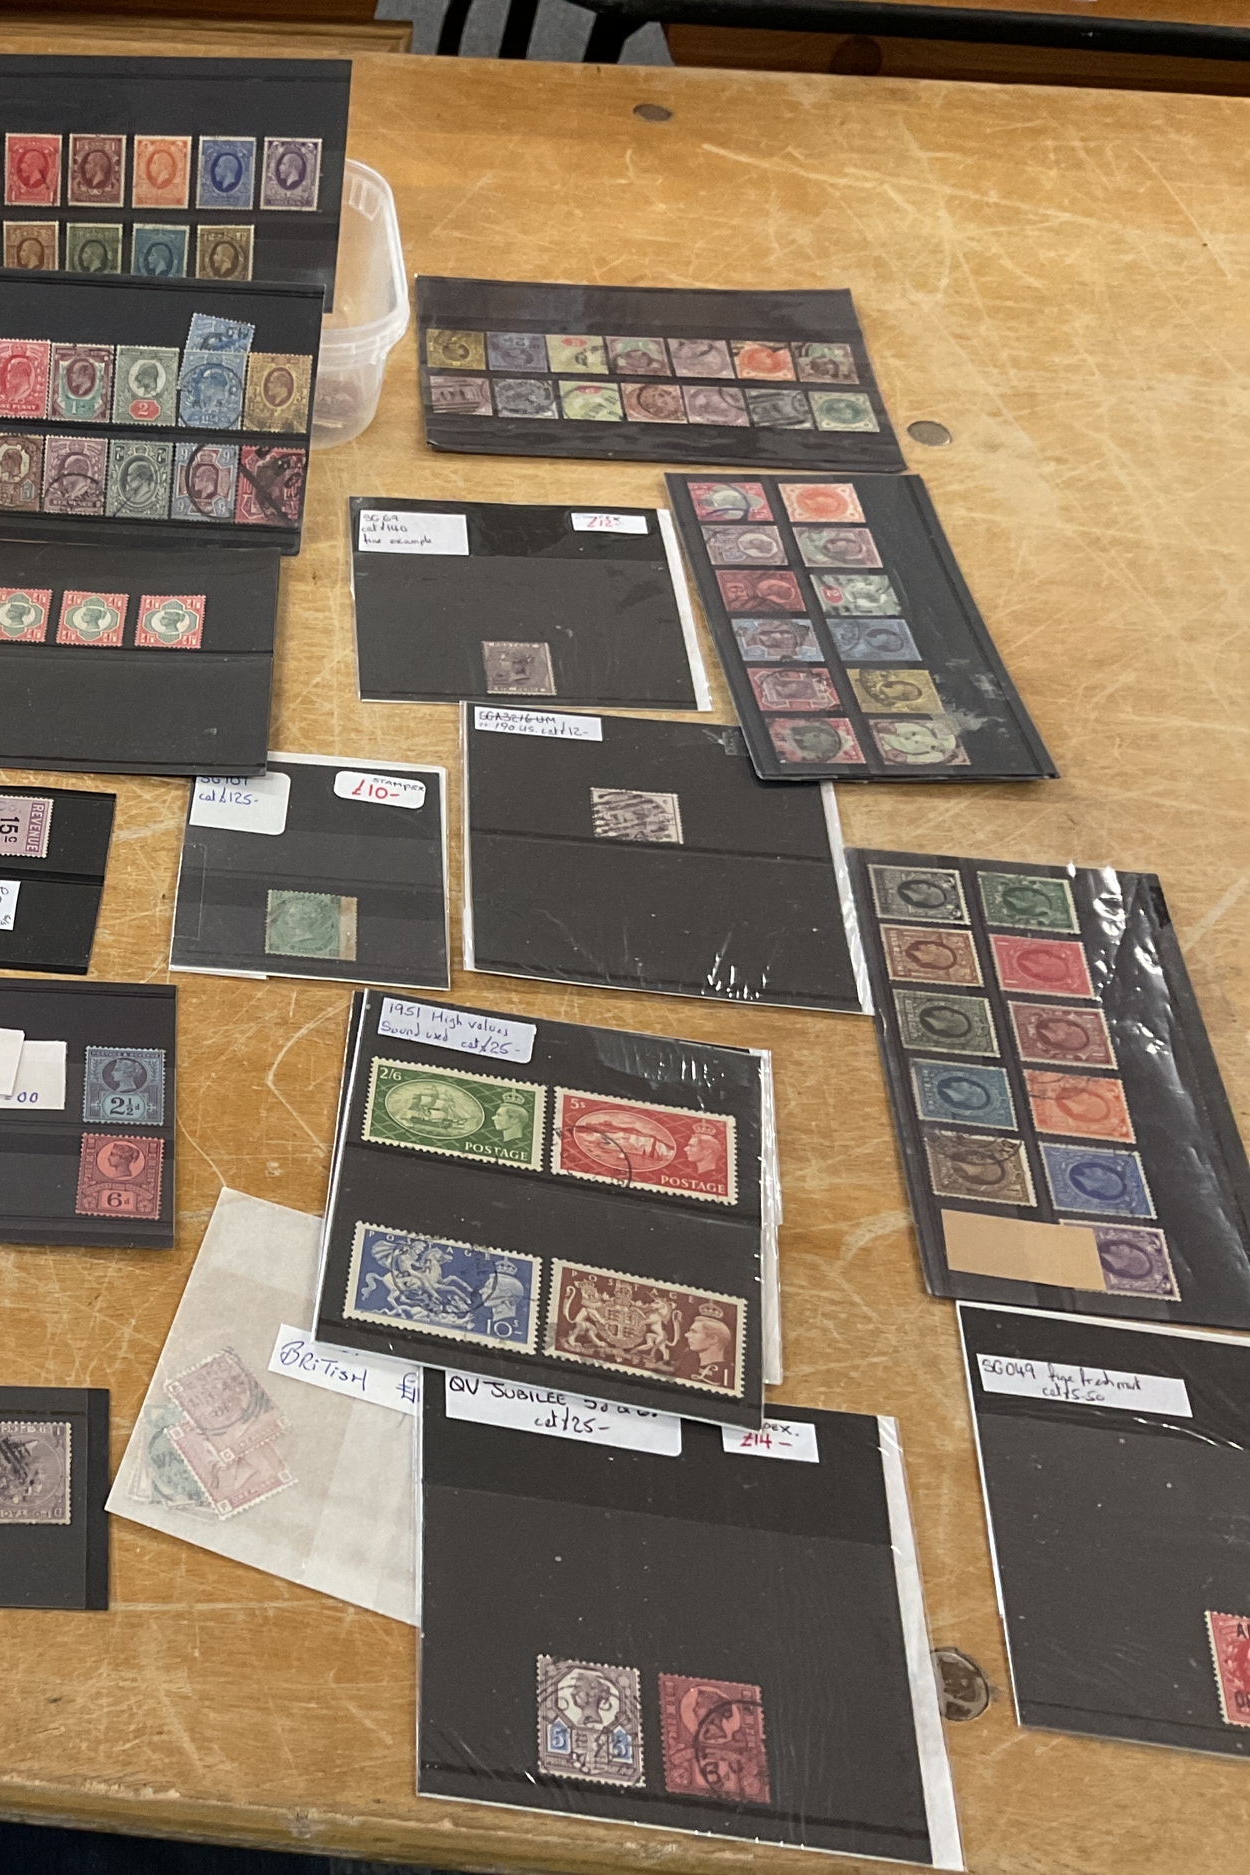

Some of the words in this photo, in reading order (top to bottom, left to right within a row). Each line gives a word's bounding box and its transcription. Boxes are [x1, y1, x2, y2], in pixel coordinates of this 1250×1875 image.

[372, 777, 424, 792] STAMPEX
[27, 803, 46, 852] REVENUE
[381, 1020, 421, 1039] Sound
[387, 1003, 422, 1019] 1951
[431, 1010, 464, 1028] High
[468, 1018, 509, 1037] values
[380, 1067, 402, 1082] 2/6
[464, 1140, 529, 1162] POSTAGE
[660, 1174, 726, 1195] POSTAGE
[106, 1192, 130, 1208] 6d
[571, 1270, 696, 1304] POSTAGE
[690, 1364, 730, 1387] £1
[449, 1375, 479, 1395] QV
[482, 1380, 567, 1406] JUBILEE
